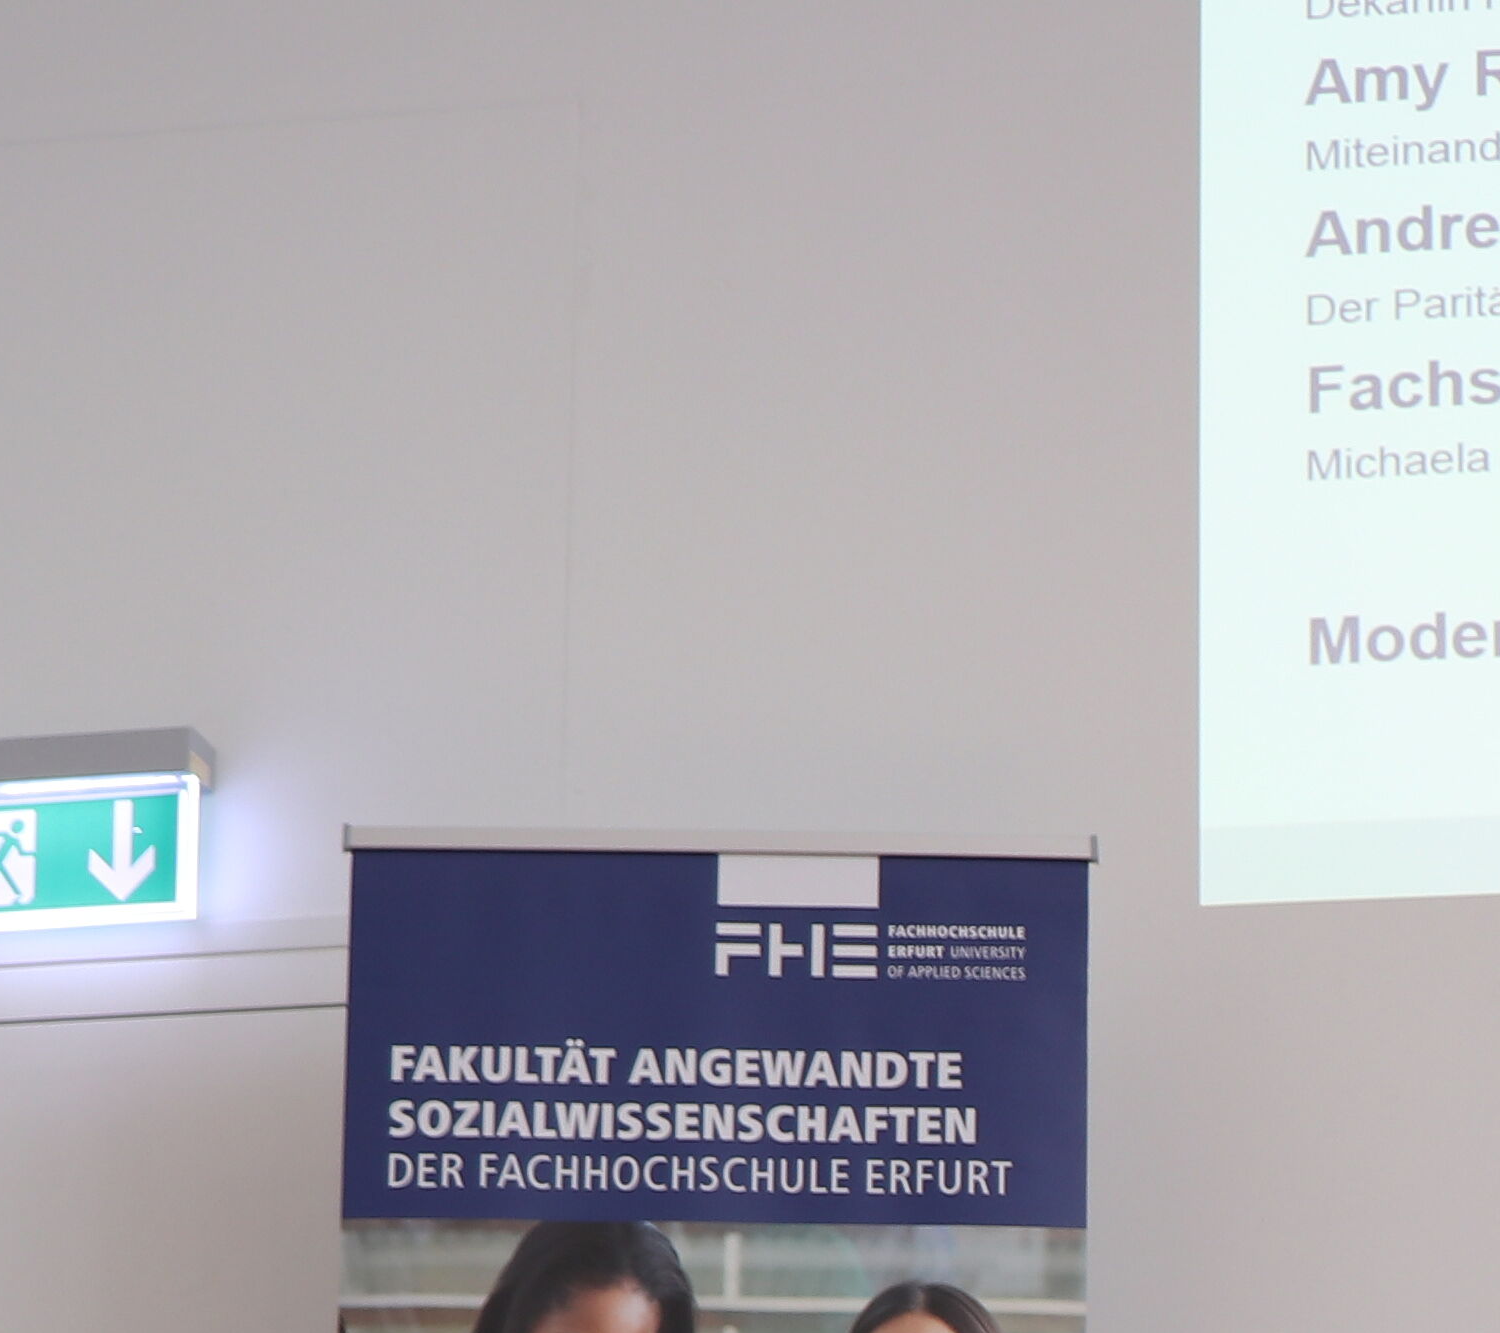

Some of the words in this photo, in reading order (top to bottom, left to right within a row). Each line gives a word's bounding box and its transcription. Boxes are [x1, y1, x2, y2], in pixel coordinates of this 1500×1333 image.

[1306, 58, 1448, 111] Amy
[1307, 294, 1378, 325] Der
[1307, 443, 1489, 481] Michaela
[715, 923, 877, 977] FHE
[888, 925, 1024, 939] FACHHOCHSCHULE
[888, 945, 944, 958] ERFURT
[950, 946, 1025, 959] UNIVERSITY
[887, 965, 904, 978] OF
[908, 966, 961, 979] APPLIED
[964, 966, 1026, 980] SCIENCES
[391, 1039, 616, 1084] FAKULTÄT
[629, 1049, 962, 1088] ANGEWANDTE
[389, 1100, 976, 1143] SOZIALWISSENSCHAFTEN
[388, 1153, 463, 1187] DER
[480, 1154, 849, 1193] FACHHOCHSCHULE
[866, 1160, 1012, 1195] ERFURT
